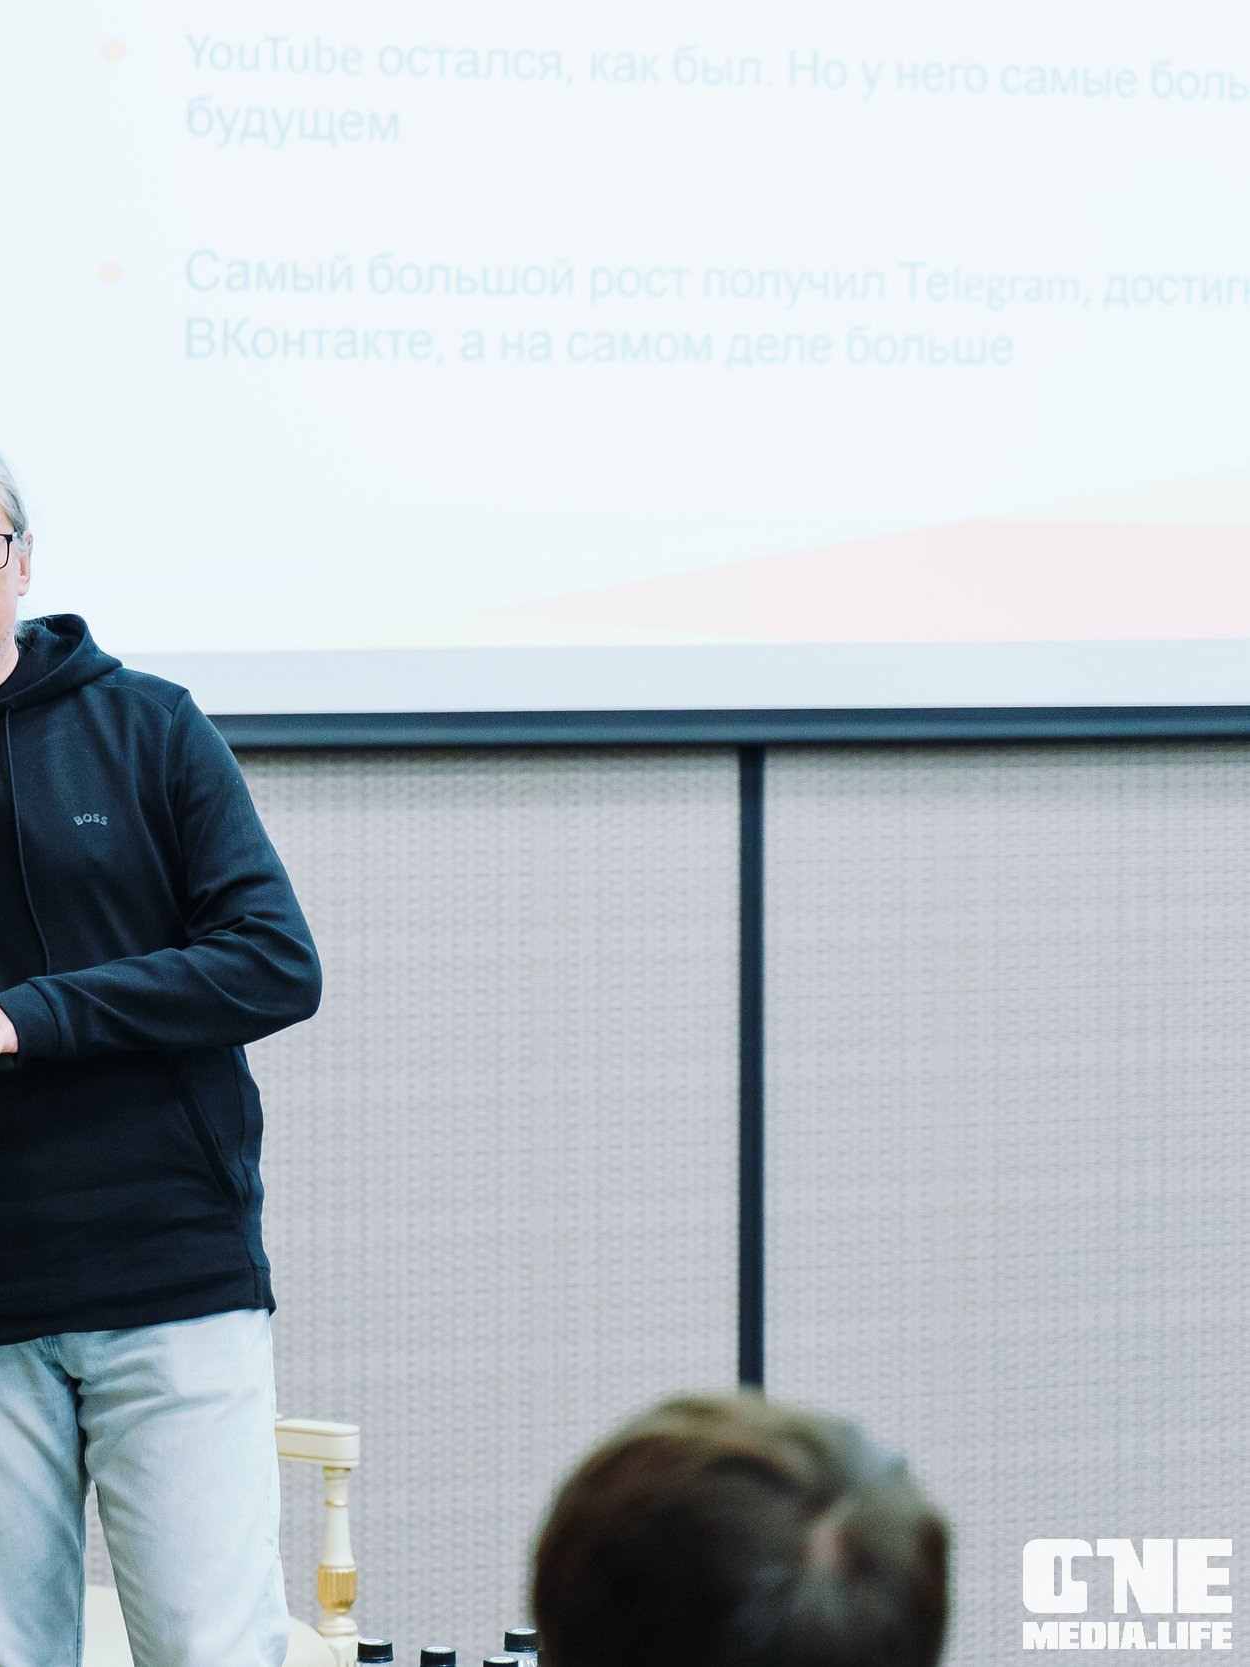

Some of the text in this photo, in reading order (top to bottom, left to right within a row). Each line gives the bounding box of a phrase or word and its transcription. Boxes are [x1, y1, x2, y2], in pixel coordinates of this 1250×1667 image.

[186, 32, 1250, 101] YouTube остался, как был. Но у него самые боль
[187, 96, 399, 151] будущем
[184, 248, 354, 293] Самый
[368, 252, 574, 297] большой
[590, 266, 690, 306] рост
[704, 267, 884, 310] получил
[899, 259, 1091, 311] Telegram,
[185, 317, 1014, 369] ВКонтакте, а на самом деле больше
[73, 813, 108, 826] BOSS
